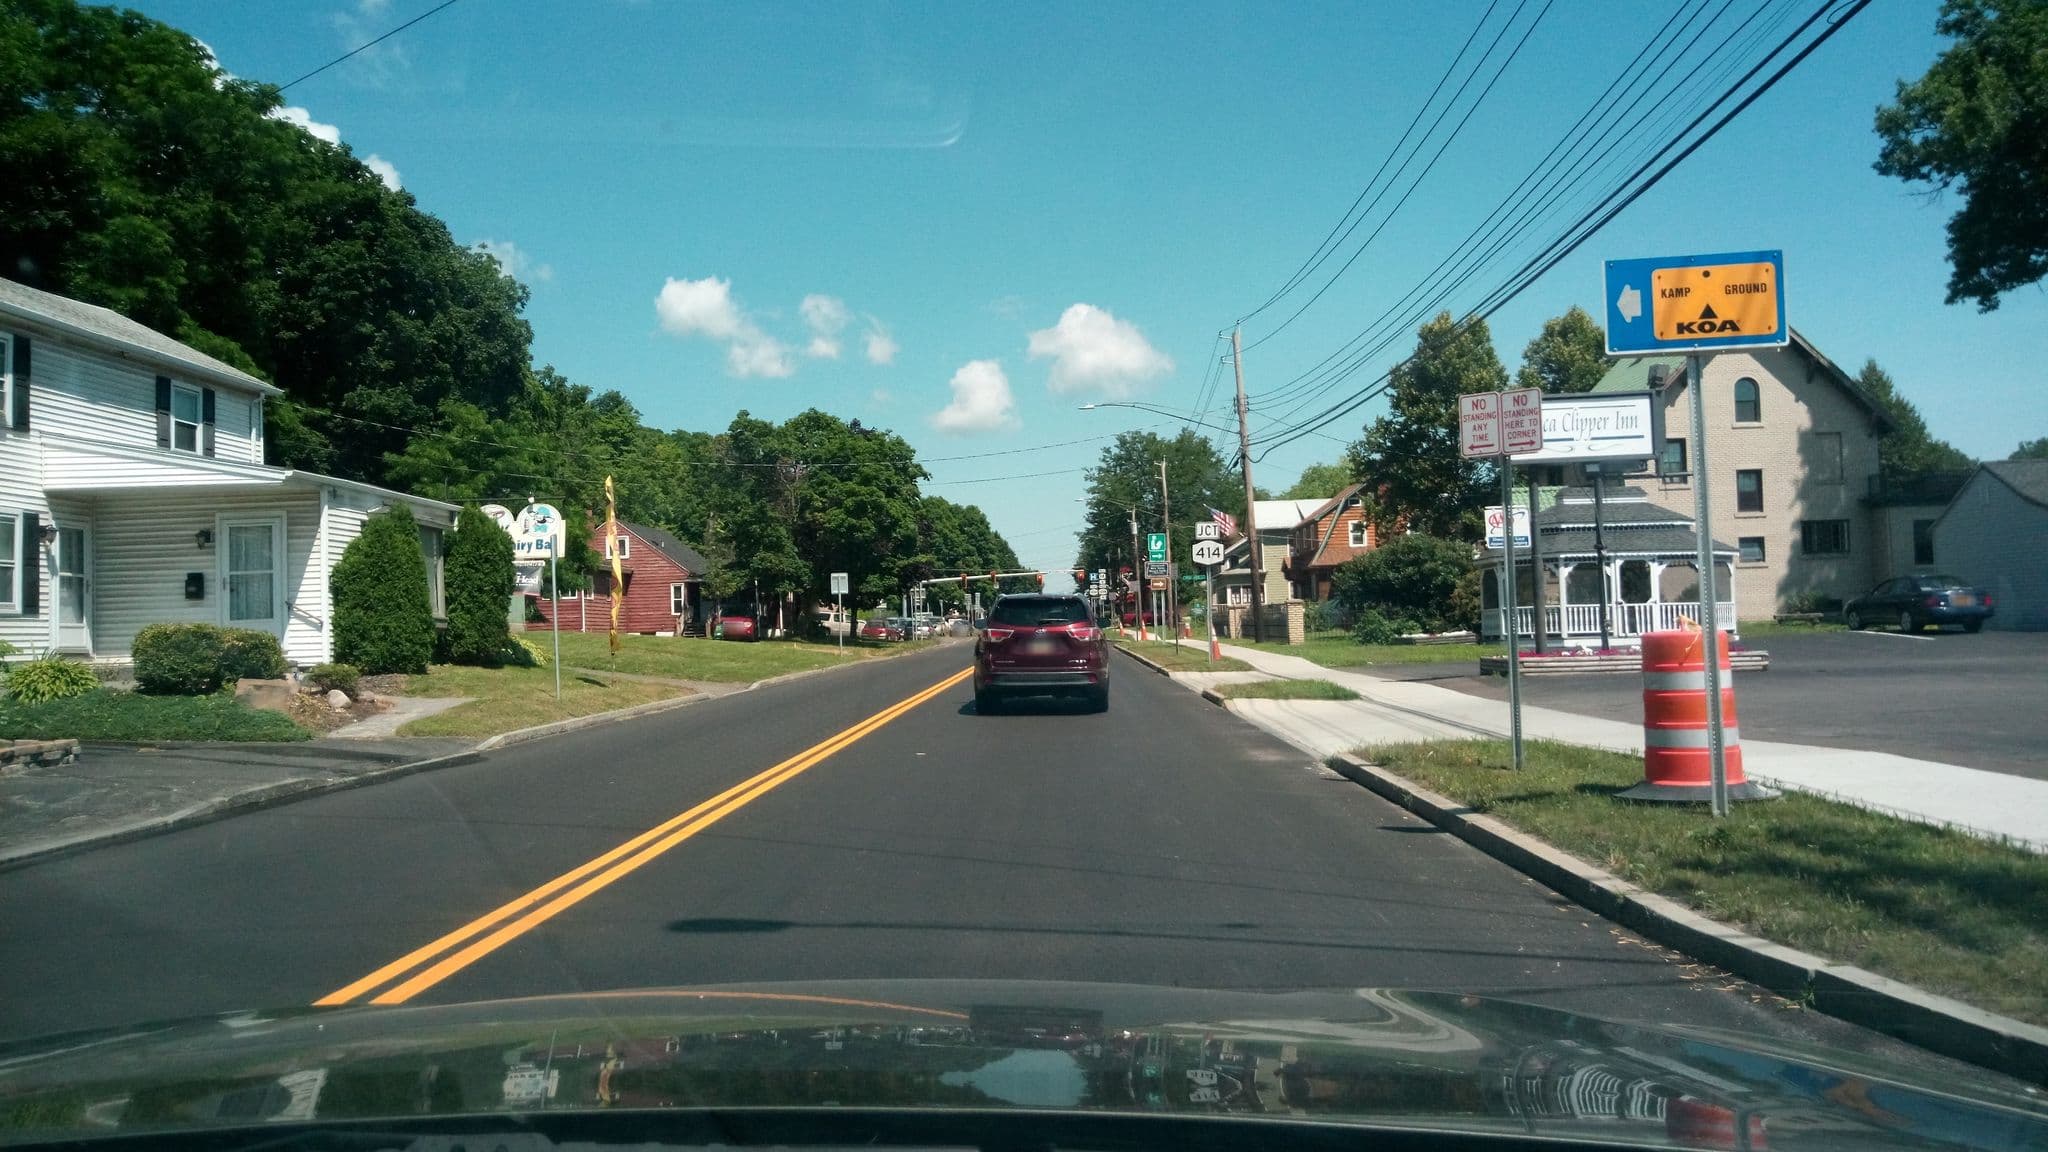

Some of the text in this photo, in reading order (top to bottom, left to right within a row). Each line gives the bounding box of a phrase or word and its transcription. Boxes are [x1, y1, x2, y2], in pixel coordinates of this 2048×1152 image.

[1661, 283, 1767, 299] KAMP GROUND
[1676, 320, 1740, 335] KOA
[1472, 399, 1487, 411] NO
[1513, 395, 1528, 407] NO
[1463, 411, 1497, 423] STANDING
[1503, 408, 1538, 419] STANDING
[1473, 423, 1488, 432] ANY
[1504, 418, 1538, 429] HERE TO
[1562, 408, 1609, 441] Clipper
[1616, 411, 1638, 429] Inn
[1472, 433, 1488, 442] TIME
[1507, 430, 1537, 440] CORNER
[1198, 525, 1218, 536] JCT
[1196, 547, 1220, 558] 414
